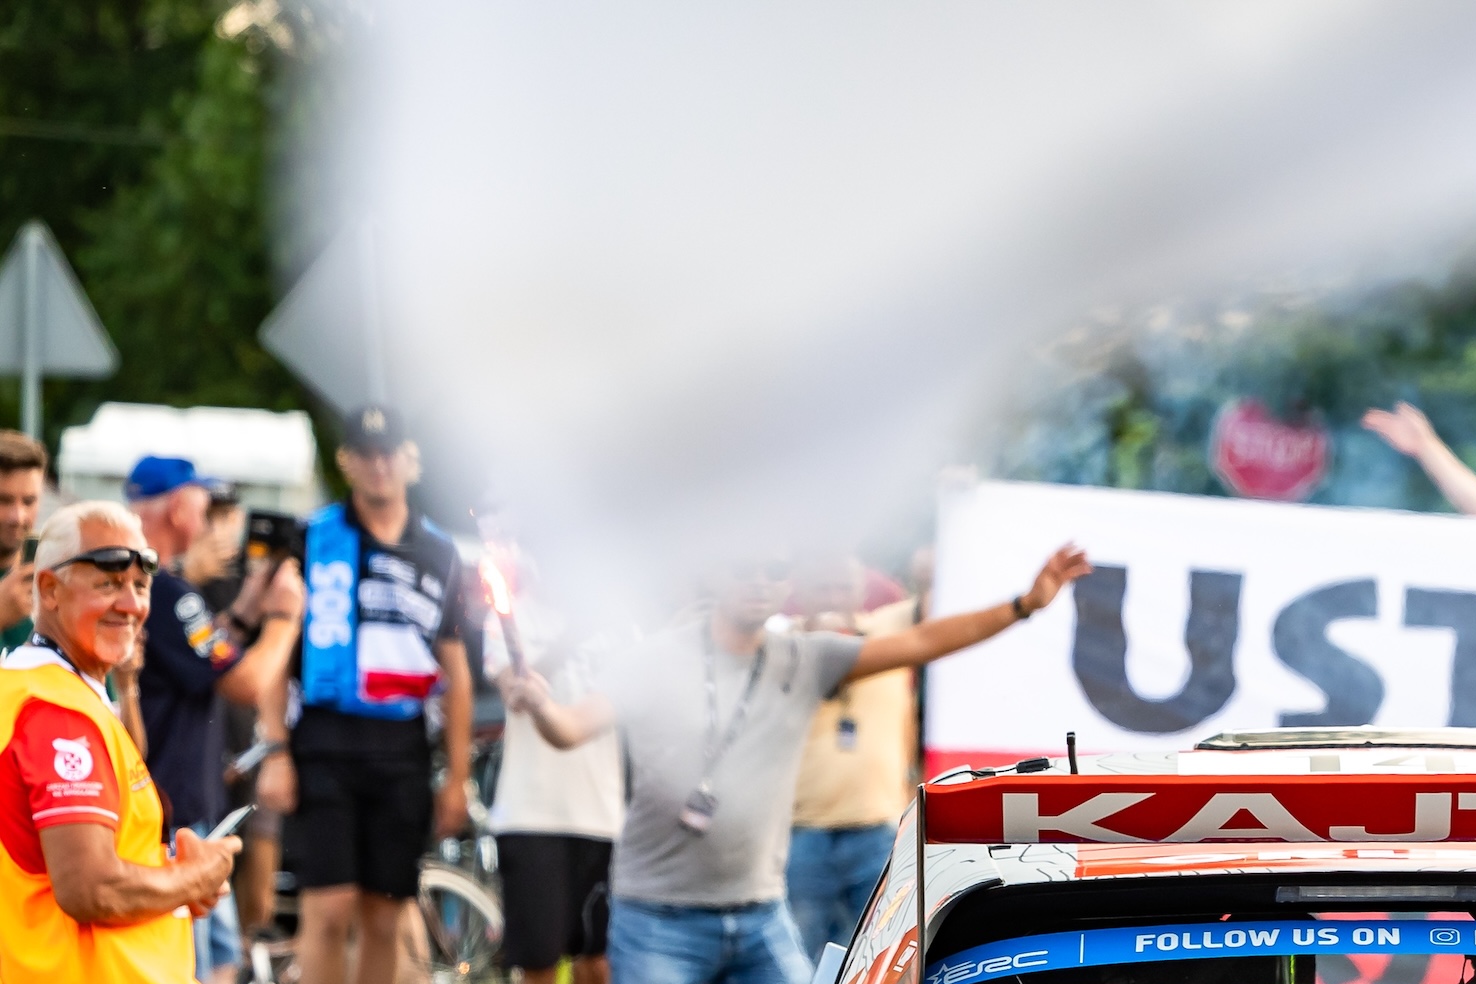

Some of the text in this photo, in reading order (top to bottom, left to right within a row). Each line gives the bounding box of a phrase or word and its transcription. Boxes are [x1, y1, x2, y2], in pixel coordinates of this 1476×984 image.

[1135, 928, 1401, 953] FOLLOW US ON
[938, 950, 1049, 984] ERC
